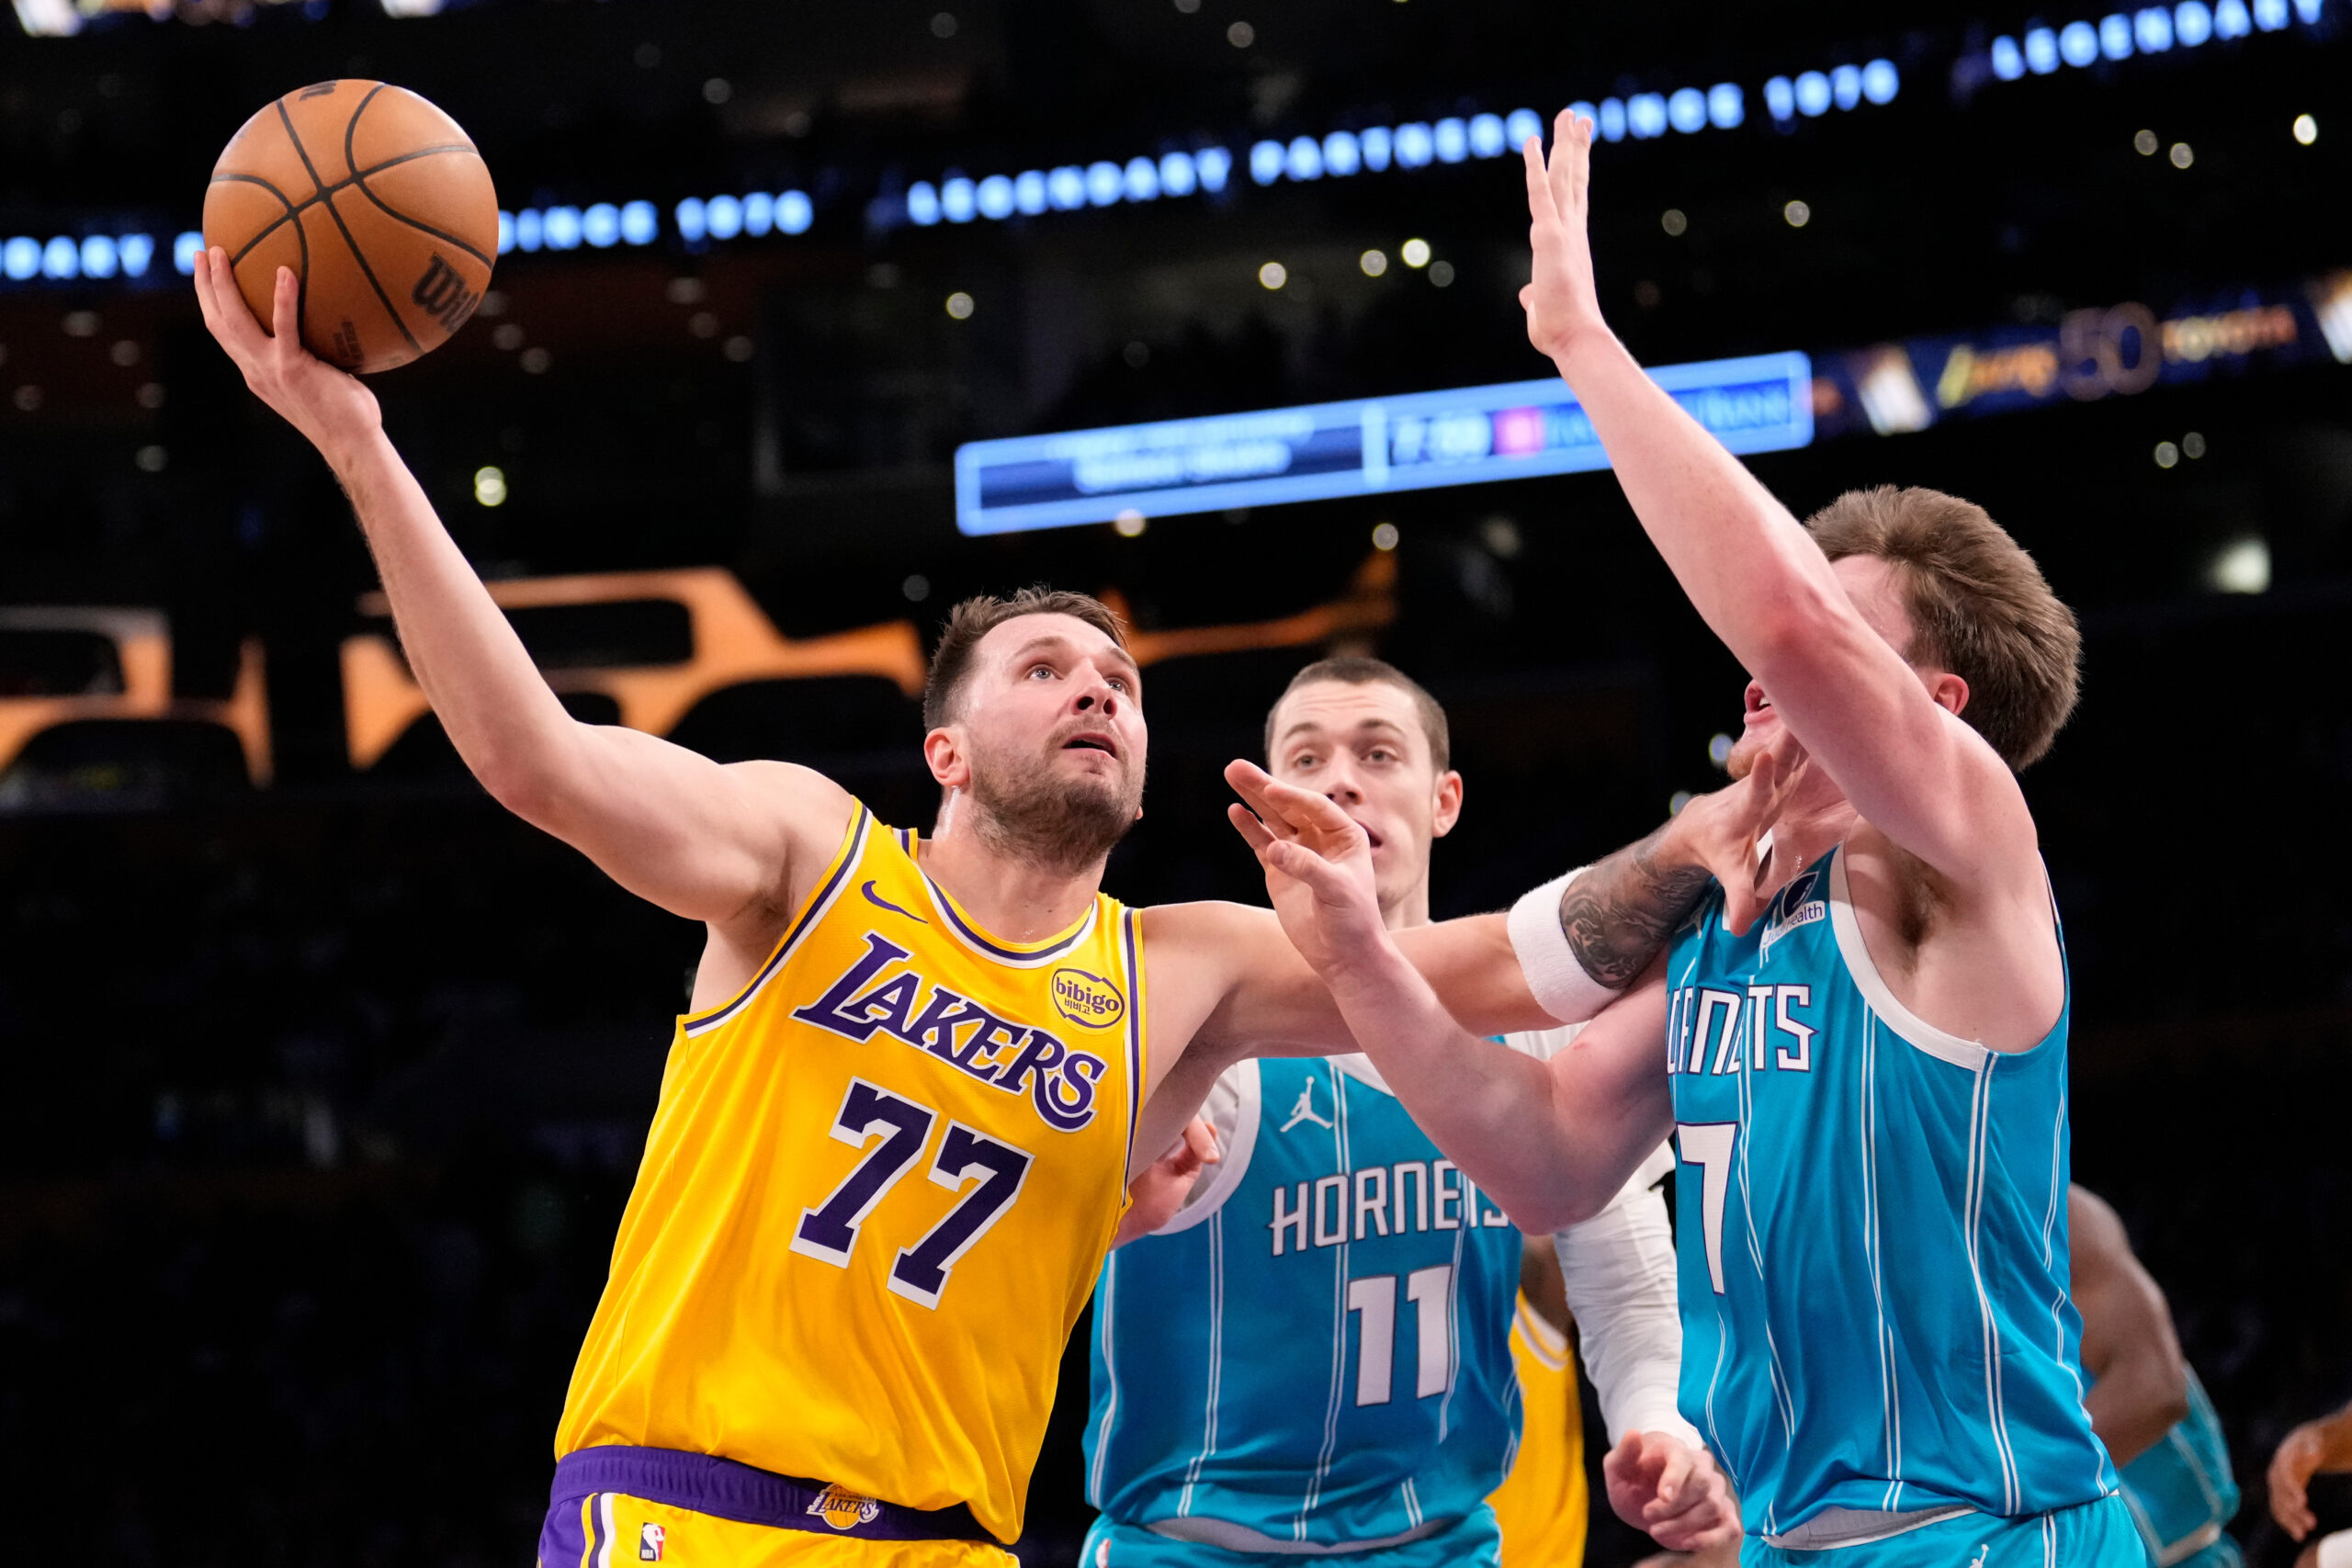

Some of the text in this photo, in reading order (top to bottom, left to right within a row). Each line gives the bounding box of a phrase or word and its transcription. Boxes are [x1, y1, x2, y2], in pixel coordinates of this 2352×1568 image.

[789, 929, 1109, 1134] LAKERS
[1056, 976, 1120, 1015] bibigo
[789, 1076, 1036, 1311] 77
[1676, 1120, 1739, 1297] 7
[1348, 1263, 1454, 1406] 11
[807, 1489, 879, 1523] LAKERS
